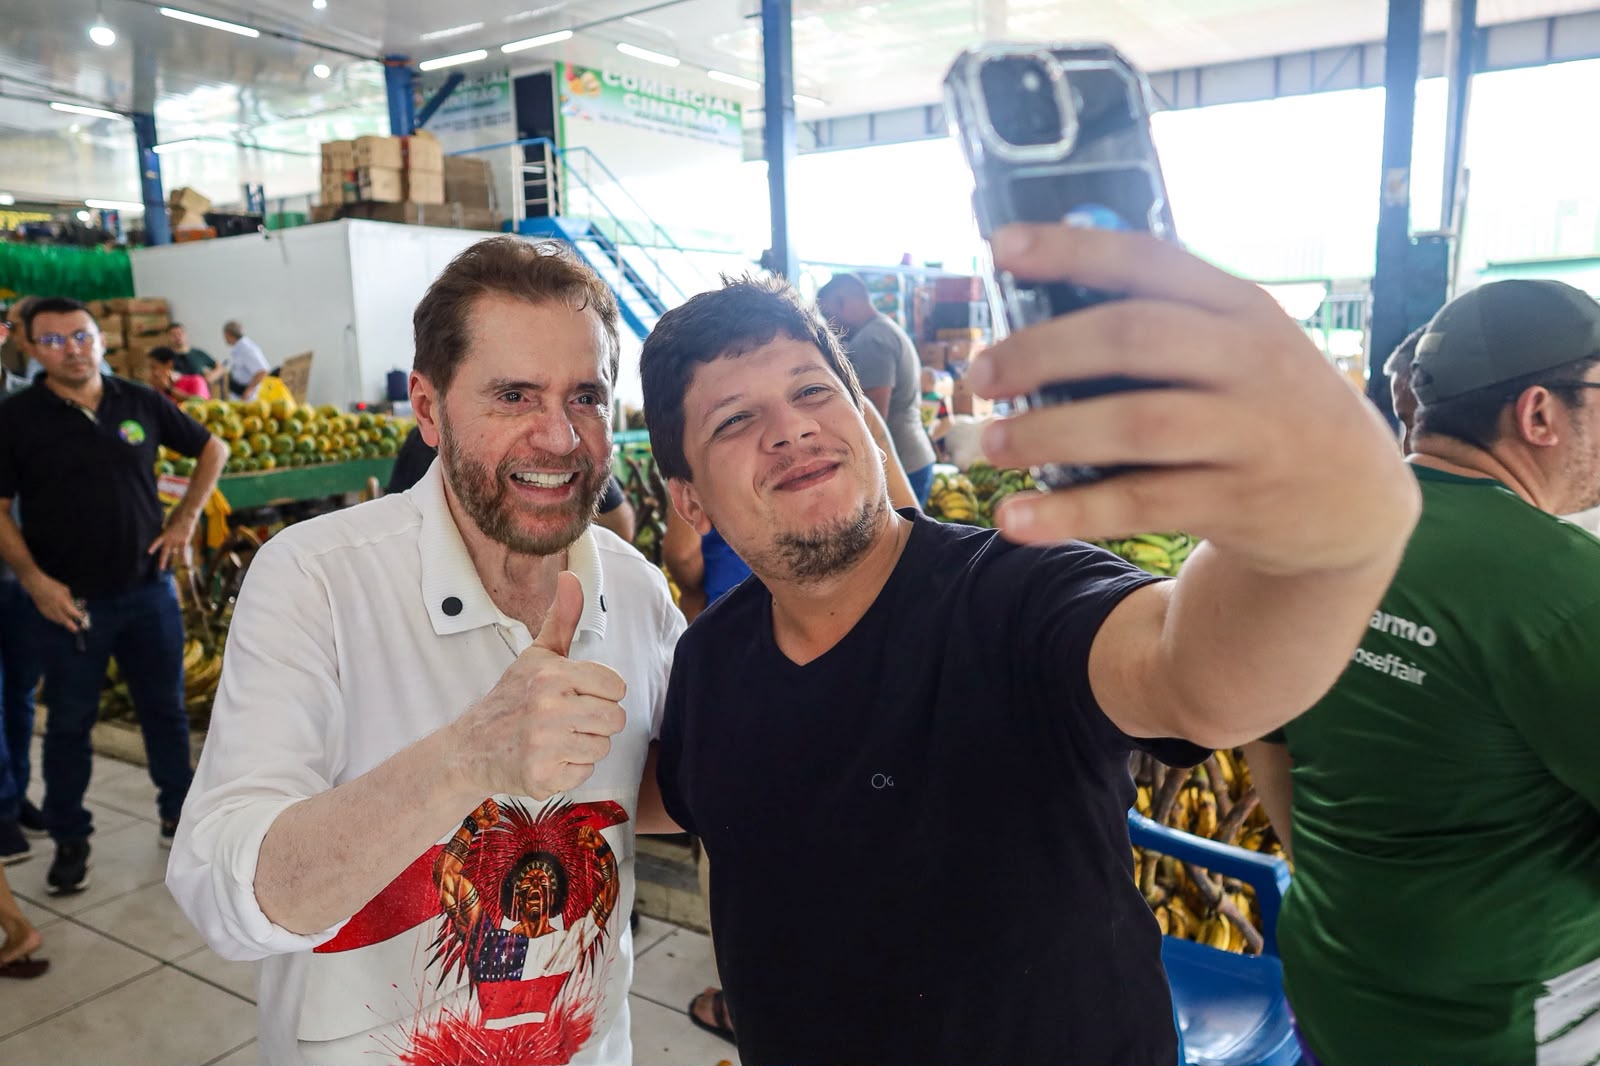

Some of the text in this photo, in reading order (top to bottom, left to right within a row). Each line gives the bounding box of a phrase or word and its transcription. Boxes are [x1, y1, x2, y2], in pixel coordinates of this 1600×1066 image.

[602, 68, 740, 116] COMERCIAL
[1369, 609, 1438, 647] armo
[1353, 648, 1427, 685] oseffair
